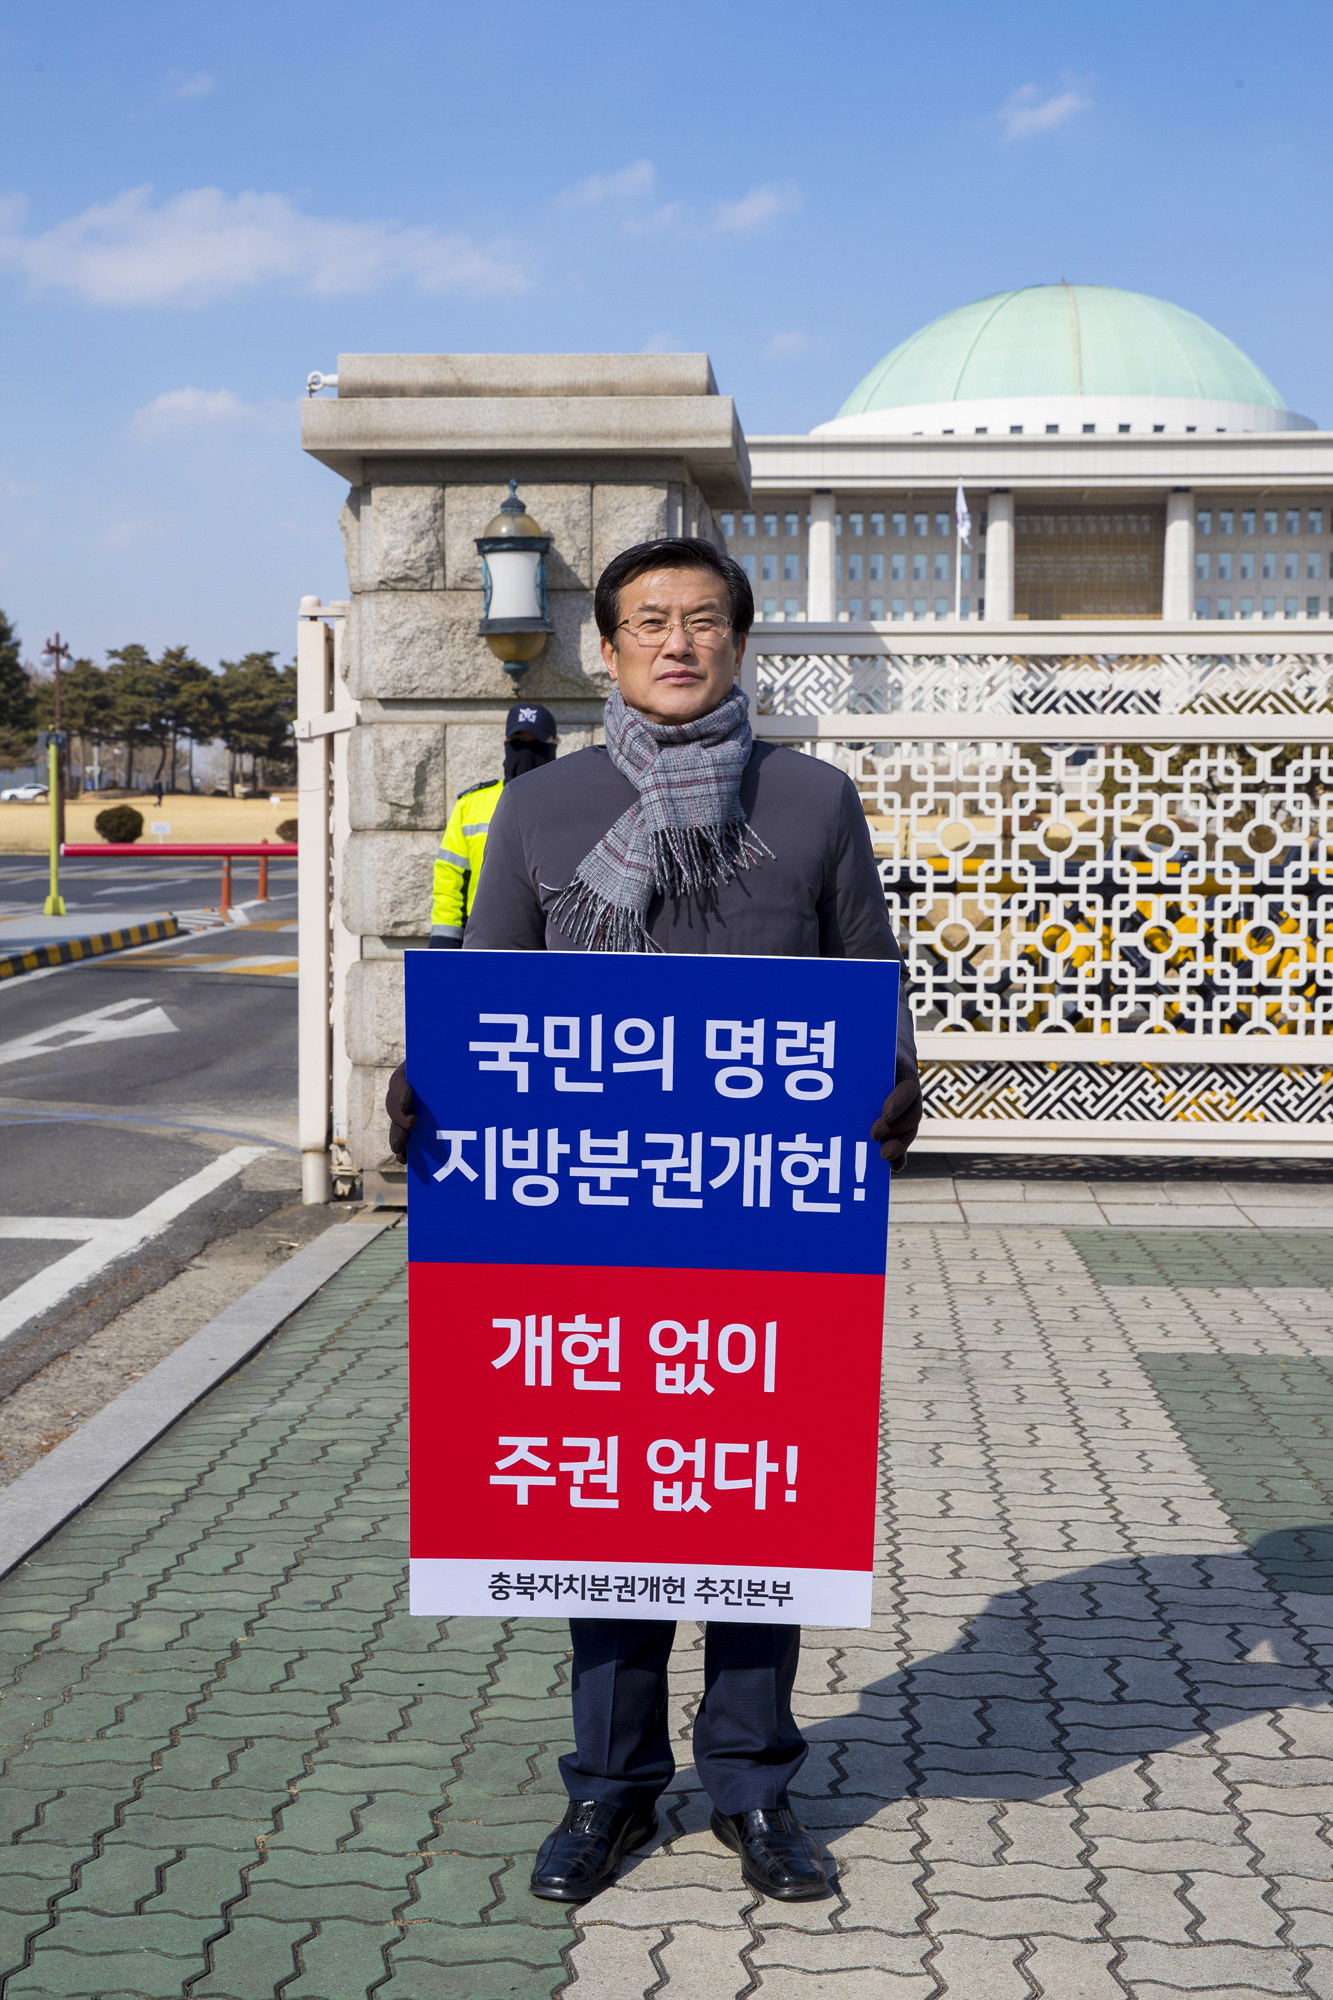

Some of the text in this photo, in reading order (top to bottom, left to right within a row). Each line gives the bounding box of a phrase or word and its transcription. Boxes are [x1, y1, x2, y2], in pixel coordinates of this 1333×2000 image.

[469, 1014, 835, 1100] 국민의 명령
[433, 1127, 867, 1213] 지방분권개헌!
[491, 1314, 776, 1395] 개헌 없이
[490, 1436, 798, 1513] 주권 없다!
[489, 1572, 793, 1607] 충북자치분권개헌 추진본부
